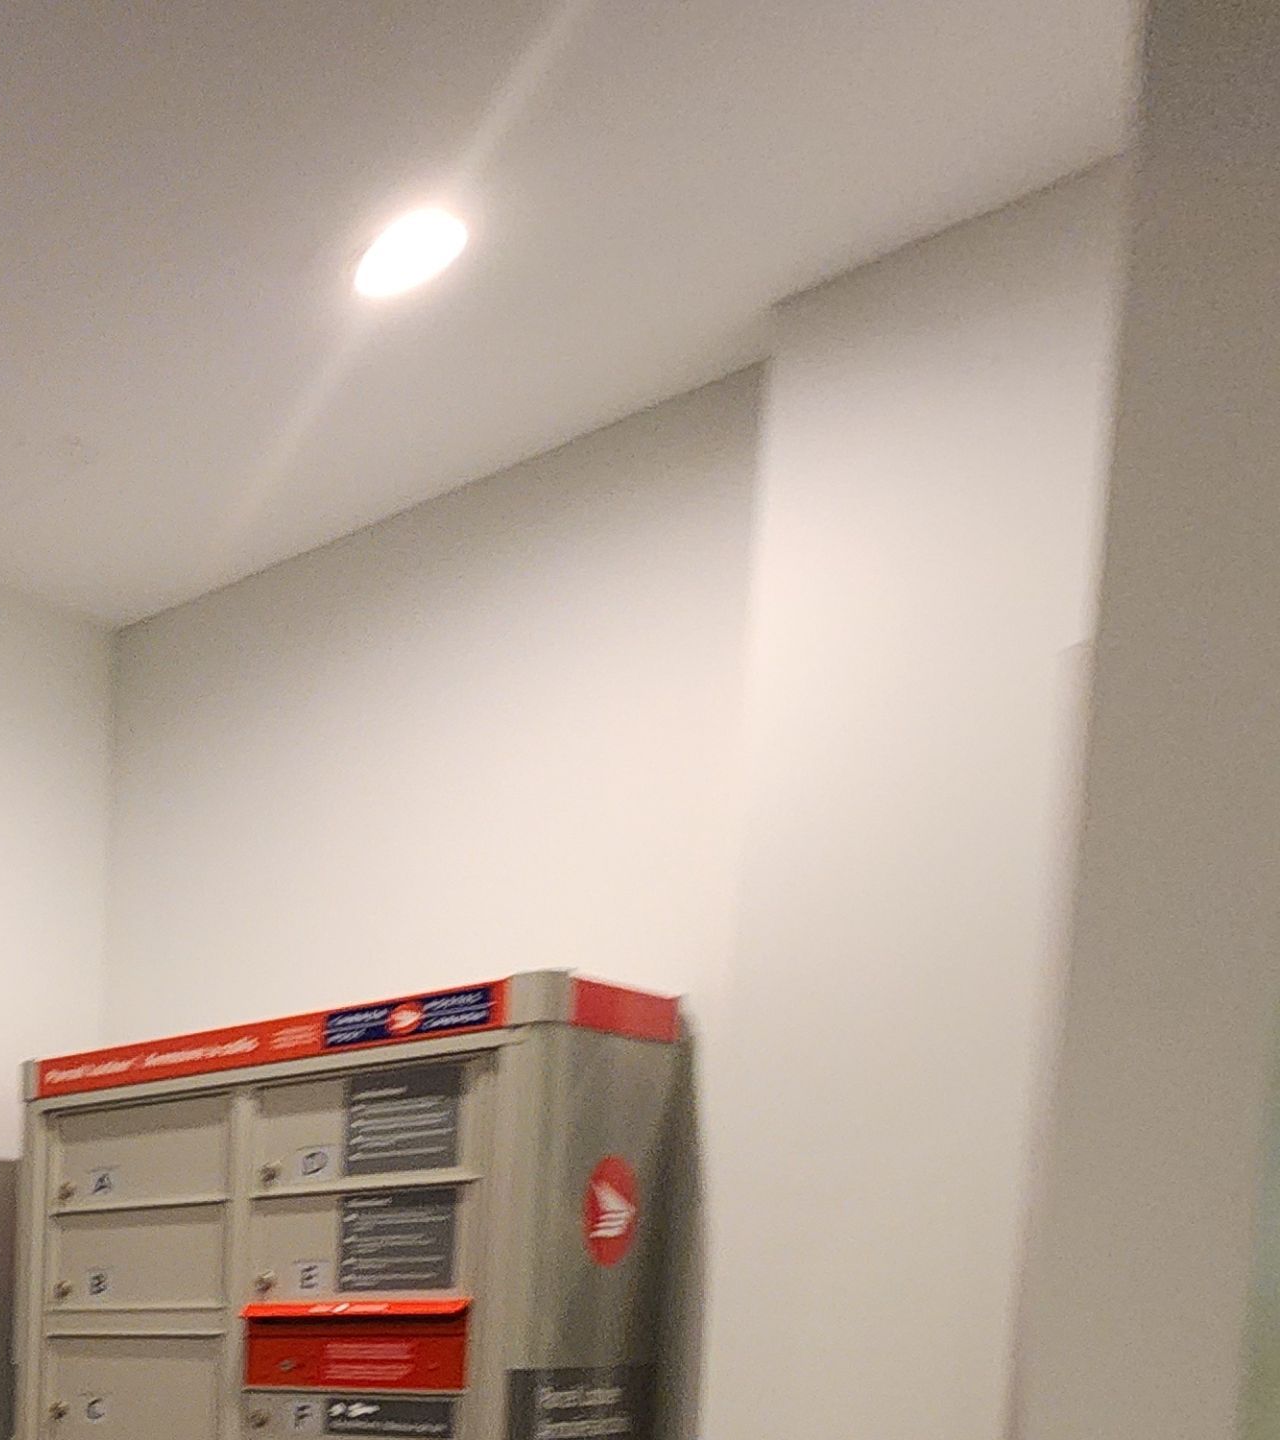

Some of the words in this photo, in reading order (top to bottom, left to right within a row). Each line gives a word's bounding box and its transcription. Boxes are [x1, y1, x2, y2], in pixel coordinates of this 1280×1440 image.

[301, 1151, 329, 1176] D
[92, 1173, 112, 1194] A
[90, 1273, 108, 1295] B
[300, 1265, 319, 1289] E
[86, 1397, 105, 1420] C
[294, 1404, 311, 1429] F
